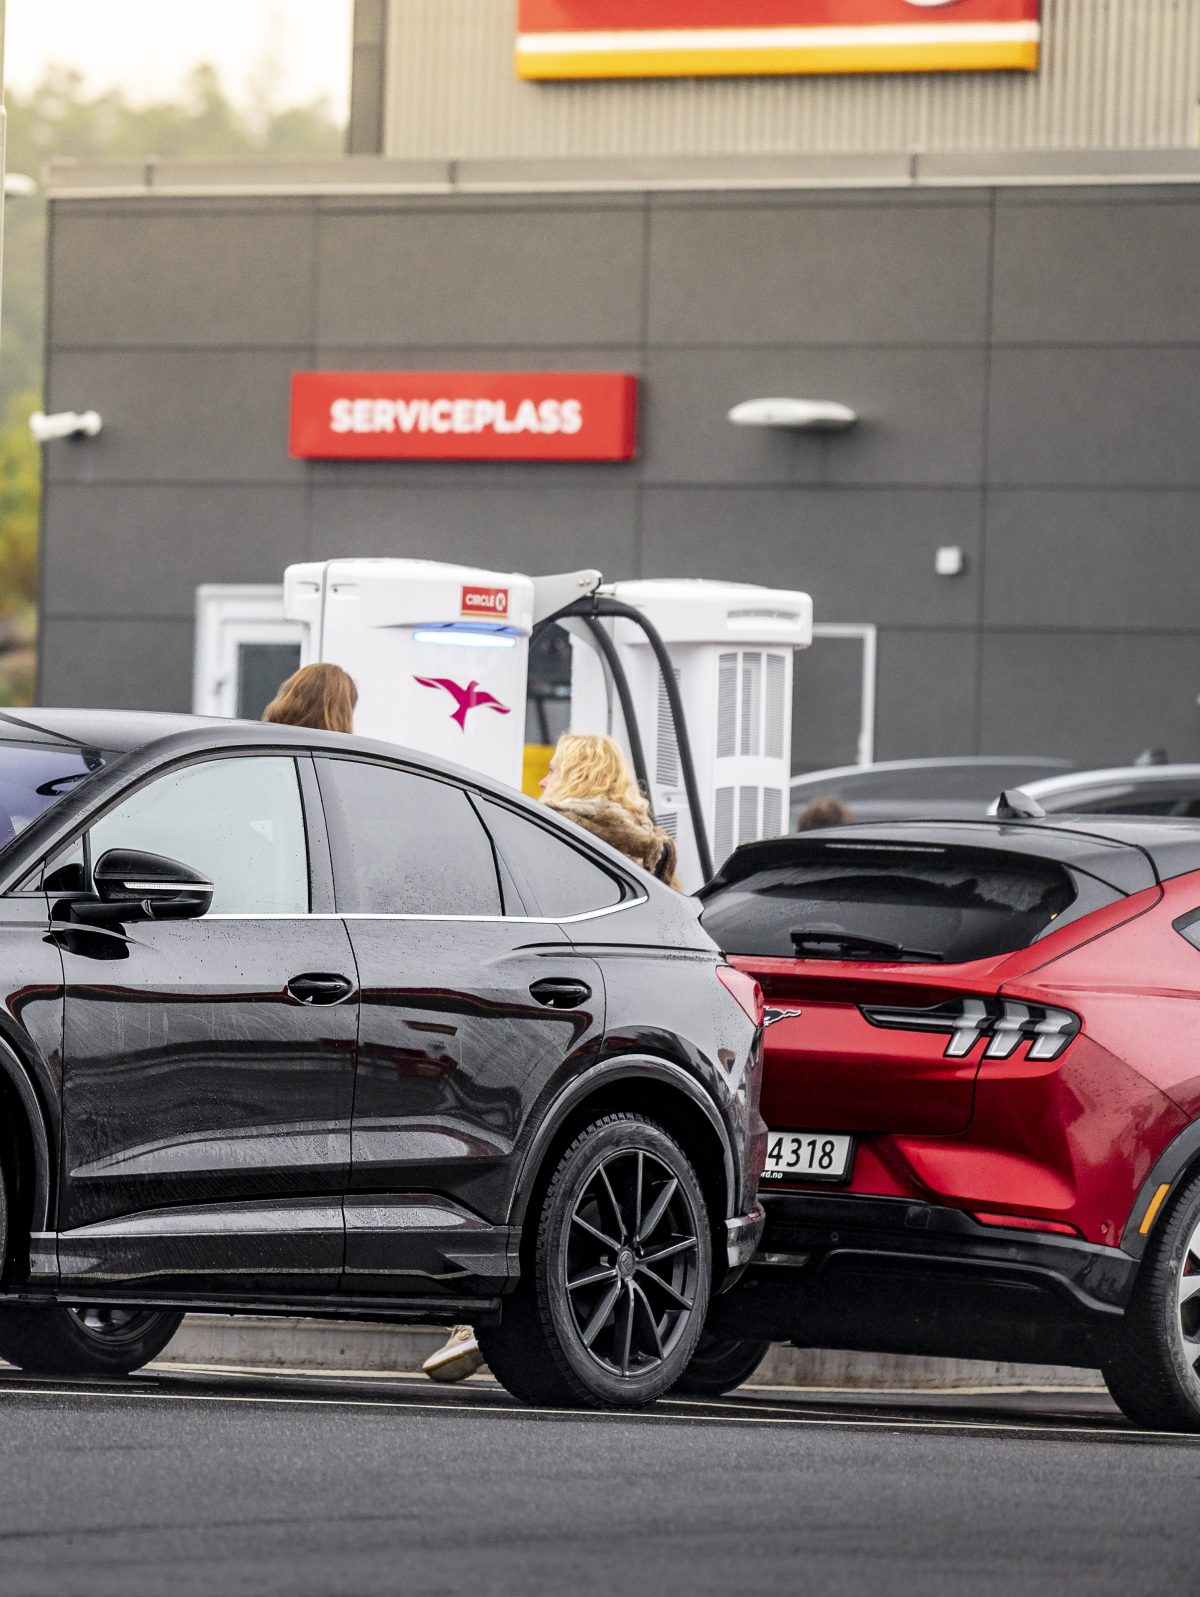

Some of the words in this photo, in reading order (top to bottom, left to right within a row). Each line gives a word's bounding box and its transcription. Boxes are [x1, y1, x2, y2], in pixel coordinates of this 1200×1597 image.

[330, 398, 582, 433] SERVICEPLASS
[465, 593, 495, 608] CIRCLE
[767, 1136, 835, 1170] 4318
